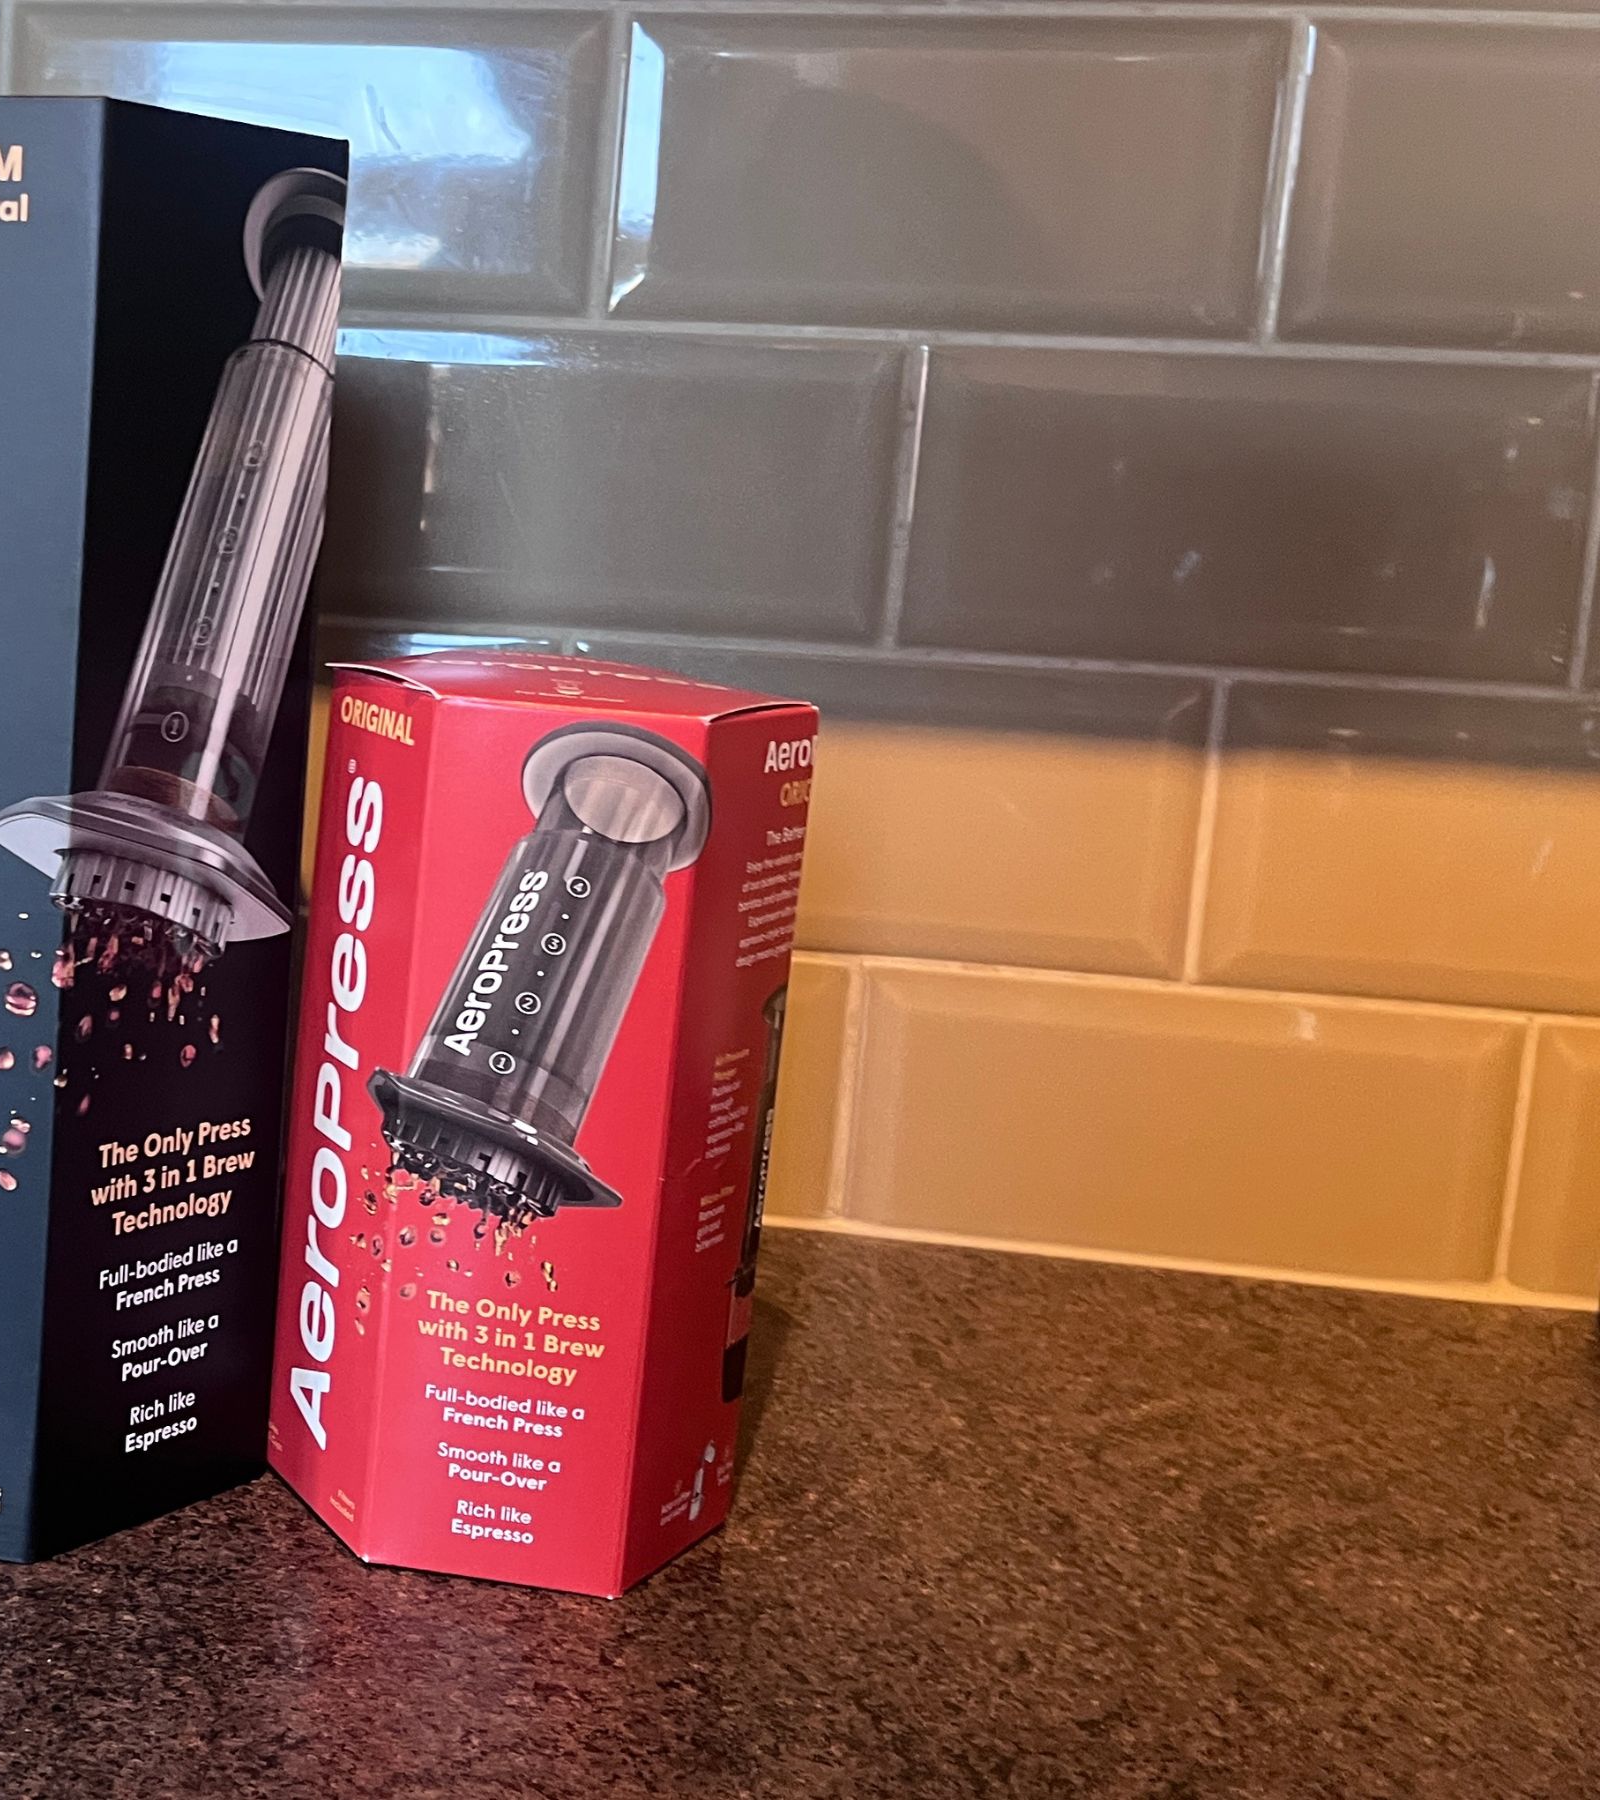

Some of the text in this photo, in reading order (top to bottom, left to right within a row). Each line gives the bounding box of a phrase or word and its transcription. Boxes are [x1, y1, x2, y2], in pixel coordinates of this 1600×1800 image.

[340, 695, 415, 746] ORIGINAL
[443, 870, 549, 1057] AeroPress
[289, 775, 384, 1452] AeroPress
[99, 1118, 252, 1168] The Only Press
[91, 1150, 256, 1207] with 3 in 1 Brew
[111, 1190, 233, 1236] Technology
[99, 1238, 239, 1290] Full-bodied like a
[115, 1268, 221, 1312] French Press
[426, 1289, 601, 1332] The Only Press
[111, 1314, 220, 1360] Smooth like a
[417, 1319, 605, 1359] with 3 in 1 Brew
[121, 1341, 208, 1382] Pour-Over
[440, 1346, 578, 1387] Technology
[129, 1393, 197, 1427] Rich like
[424, 1383, 585, 1421] Full-bodied like a
[442, 1406, 564, 1438] French Press
[124, 1417, 198, 1454] Espresso
[436, 1441, 561, 1474] Smooth like a
[447, 1463, 548, 1491] Pour-Over
[450, 1518, 535, 1545] Espresso
[456, 1499, 533, 1525] Rich like
